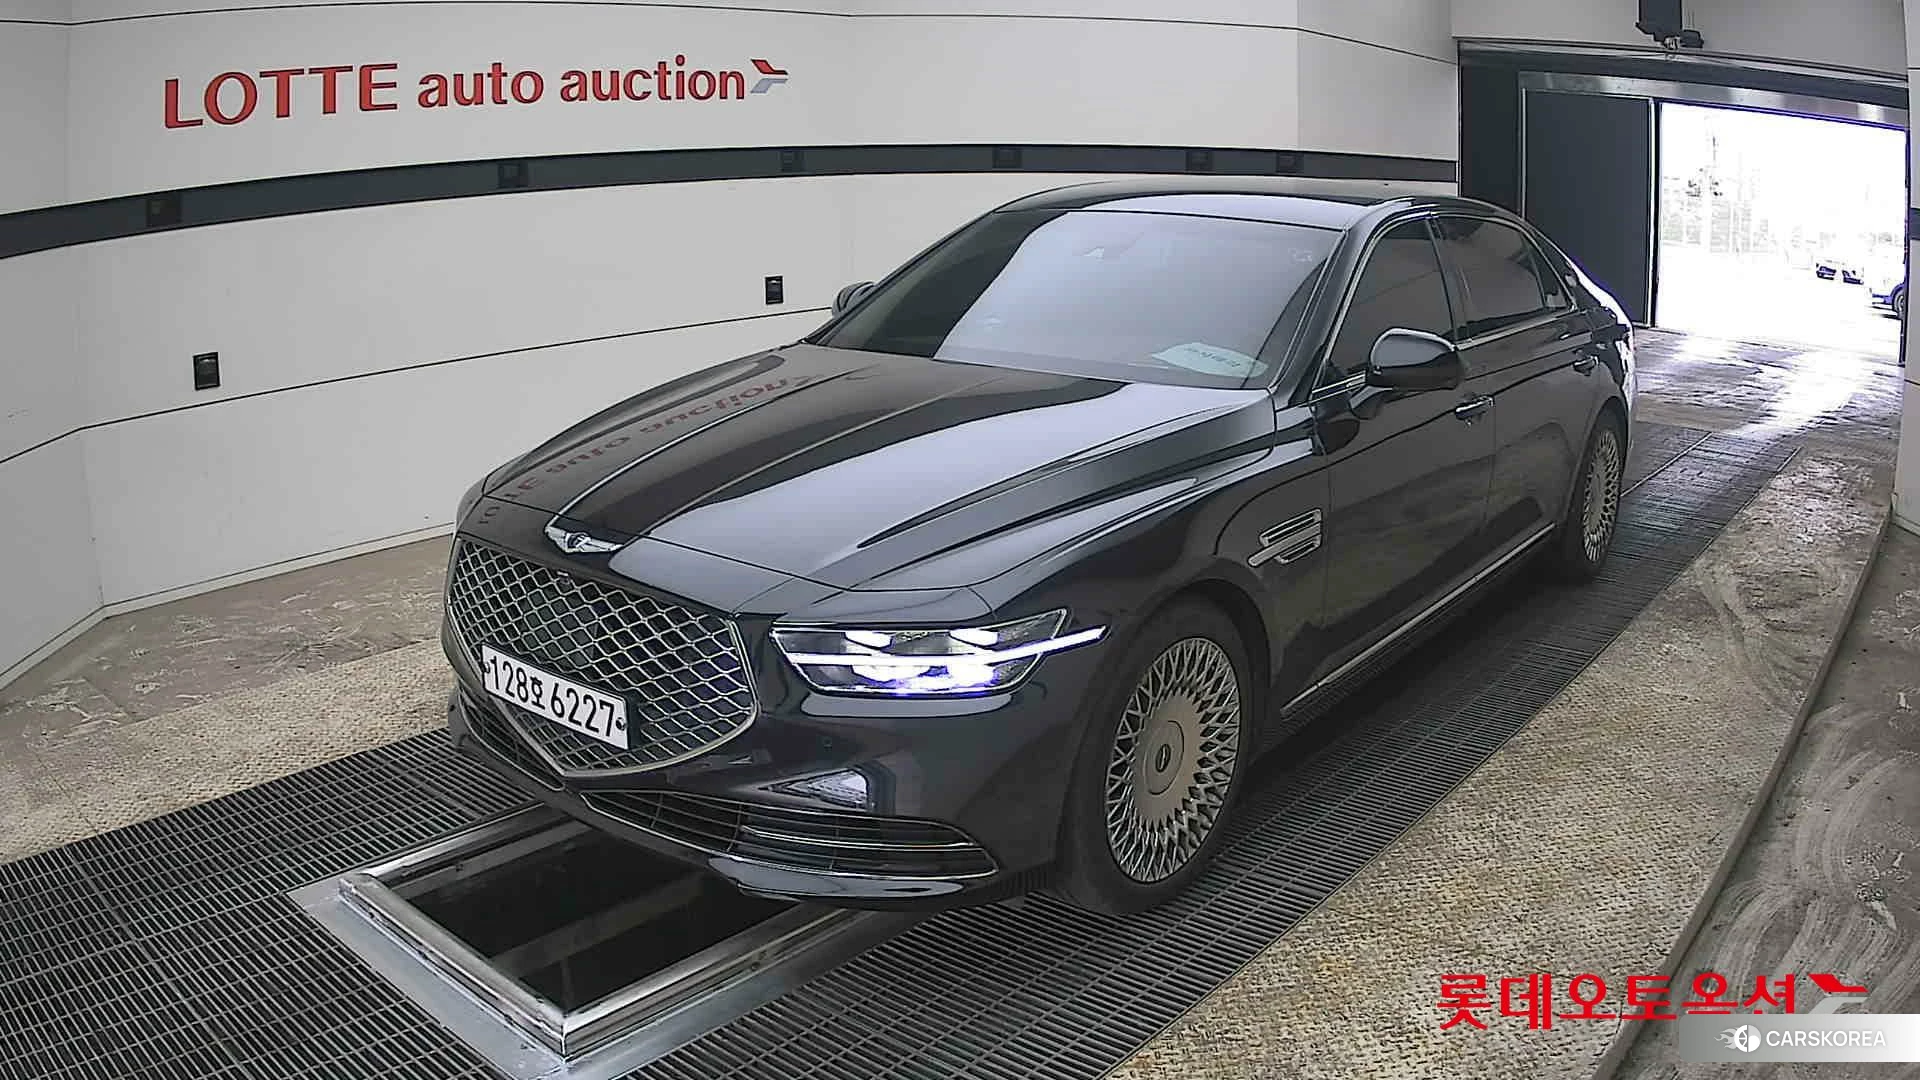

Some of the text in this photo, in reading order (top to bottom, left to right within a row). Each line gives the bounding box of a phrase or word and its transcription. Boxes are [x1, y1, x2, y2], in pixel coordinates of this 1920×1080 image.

[164, 55, 746, 129] LOTTE auto auction
[550, 682, 616, 738] 6227
